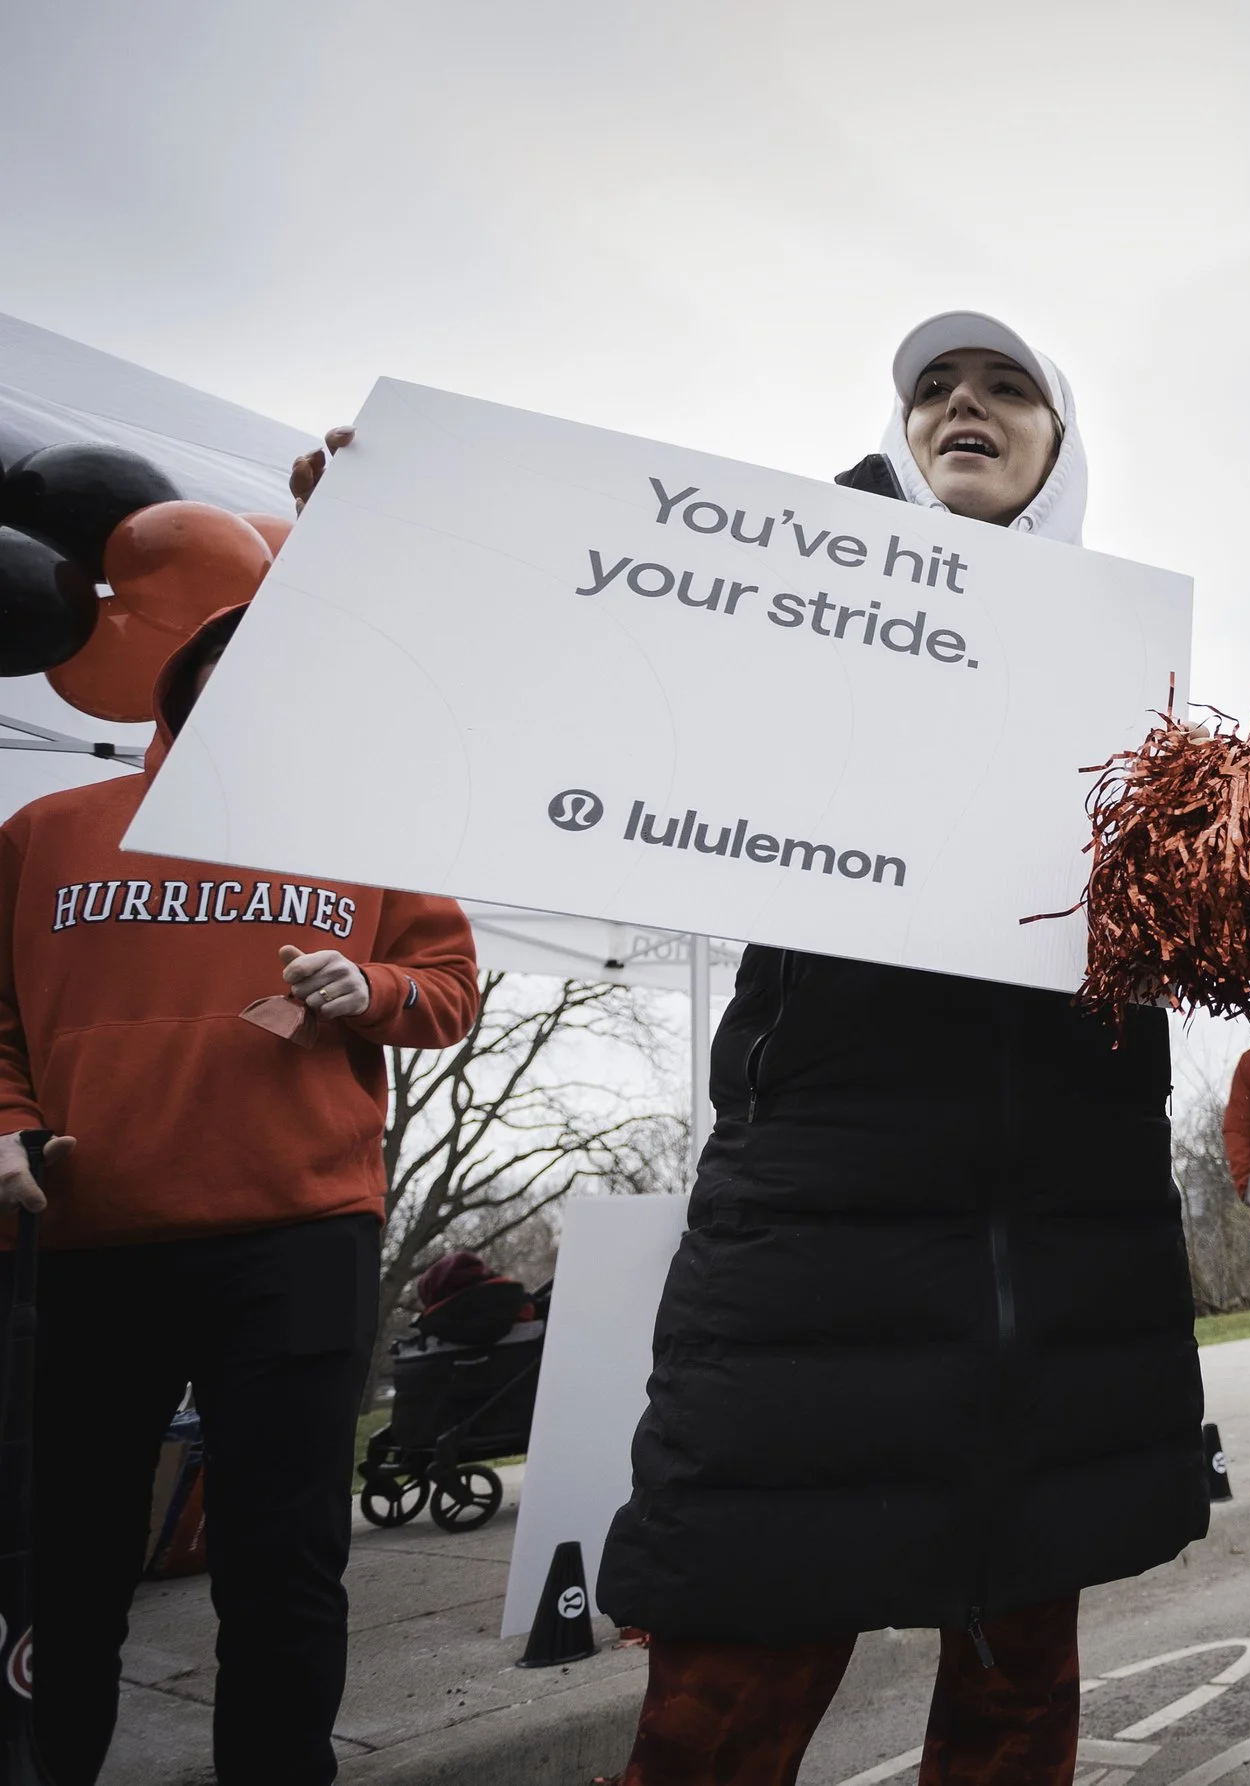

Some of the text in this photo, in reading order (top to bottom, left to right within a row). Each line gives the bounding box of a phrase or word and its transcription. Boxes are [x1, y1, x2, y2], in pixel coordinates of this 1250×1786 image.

[882, 534, 968, 595] hit
[575, 549, 980, 670] your stride.
[622, 799, 907, 887] lululemon
[52, 879, 357, 940] HURRICANES
